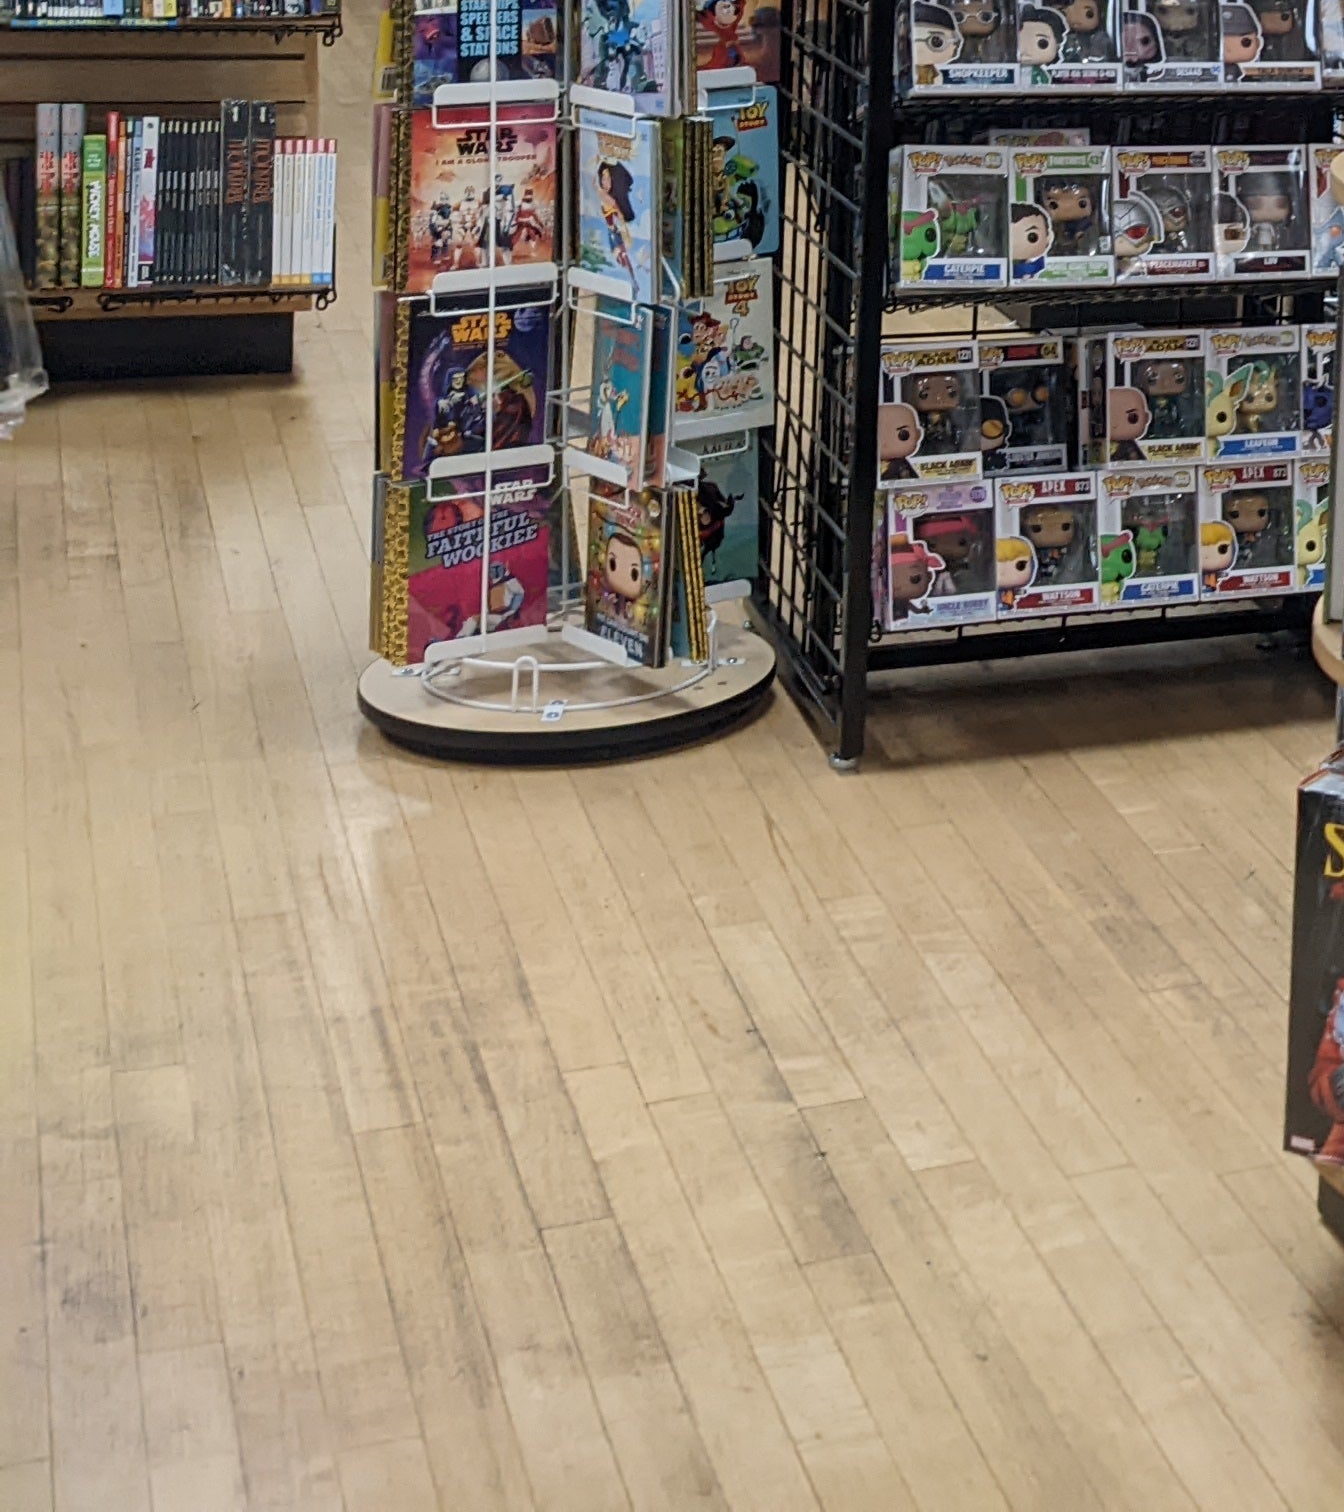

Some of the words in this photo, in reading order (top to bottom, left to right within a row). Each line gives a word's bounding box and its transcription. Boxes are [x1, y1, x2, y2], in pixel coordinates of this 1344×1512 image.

[461, 26, 473, 42] &
[737, 102, 769, 119] TOY
[457, 129, 518, 141] STAR
[457, 140, 518, 154] WARS
[944, 264, 985, 275] CATERPIE
[724, 273, 761, 294] TOY
[733, 300, 750, 317] 4
[456, 312, 511, 328] STAR
[451, 324, 512, 344] WARS
[916, 355, 957, 367] ADAM
[1242, 466, 1266, 479] APEX
[1041, 481, 1066, 493] APEX
[490, 489, 537, 506] WARS
[601, 626, 647, 658] ELEVEN
